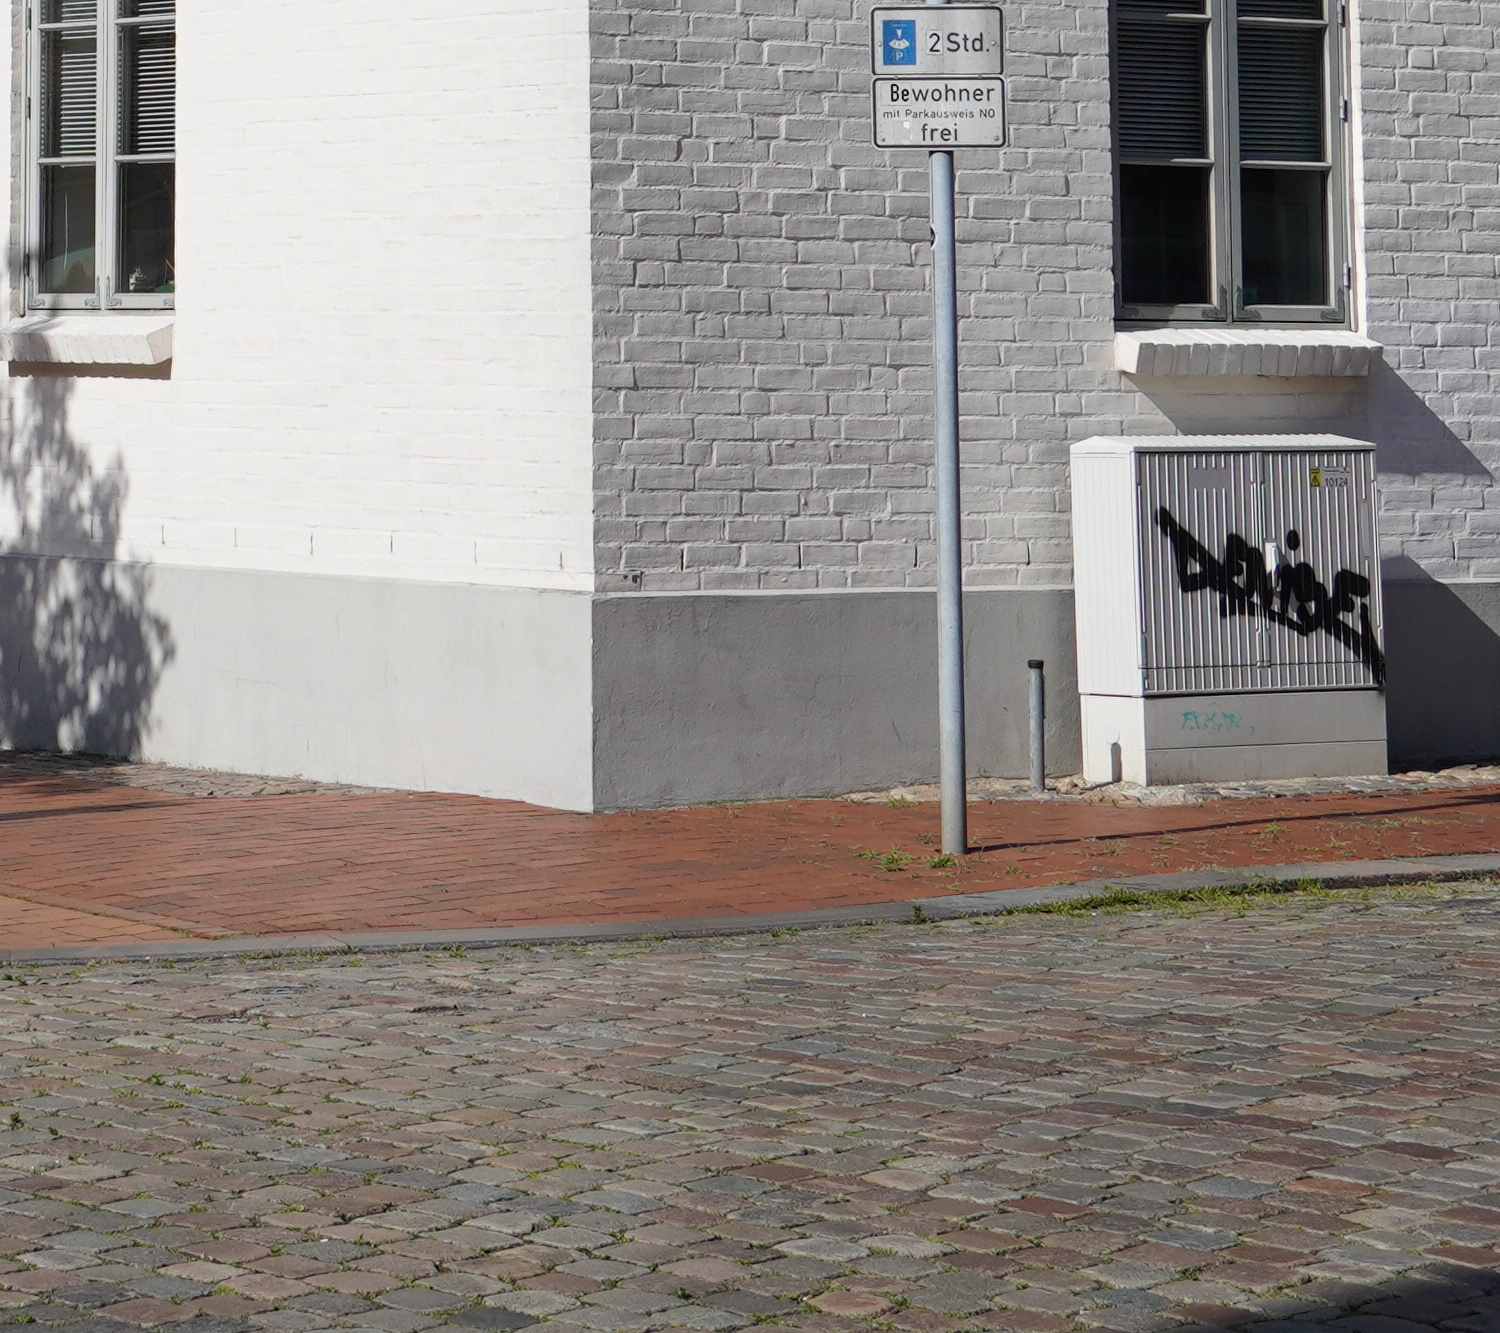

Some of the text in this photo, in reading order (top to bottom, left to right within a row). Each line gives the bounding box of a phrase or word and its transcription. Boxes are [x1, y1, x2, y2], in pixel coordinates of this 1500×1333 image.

[928, 32, 990, 53] 2 Std.
[890, 83, 996, 102] Bewohner
[882, 108, 900, 119] mit
[905, 108, 975, 119] Parkausweis
[921, 122, 958, 142] frei
